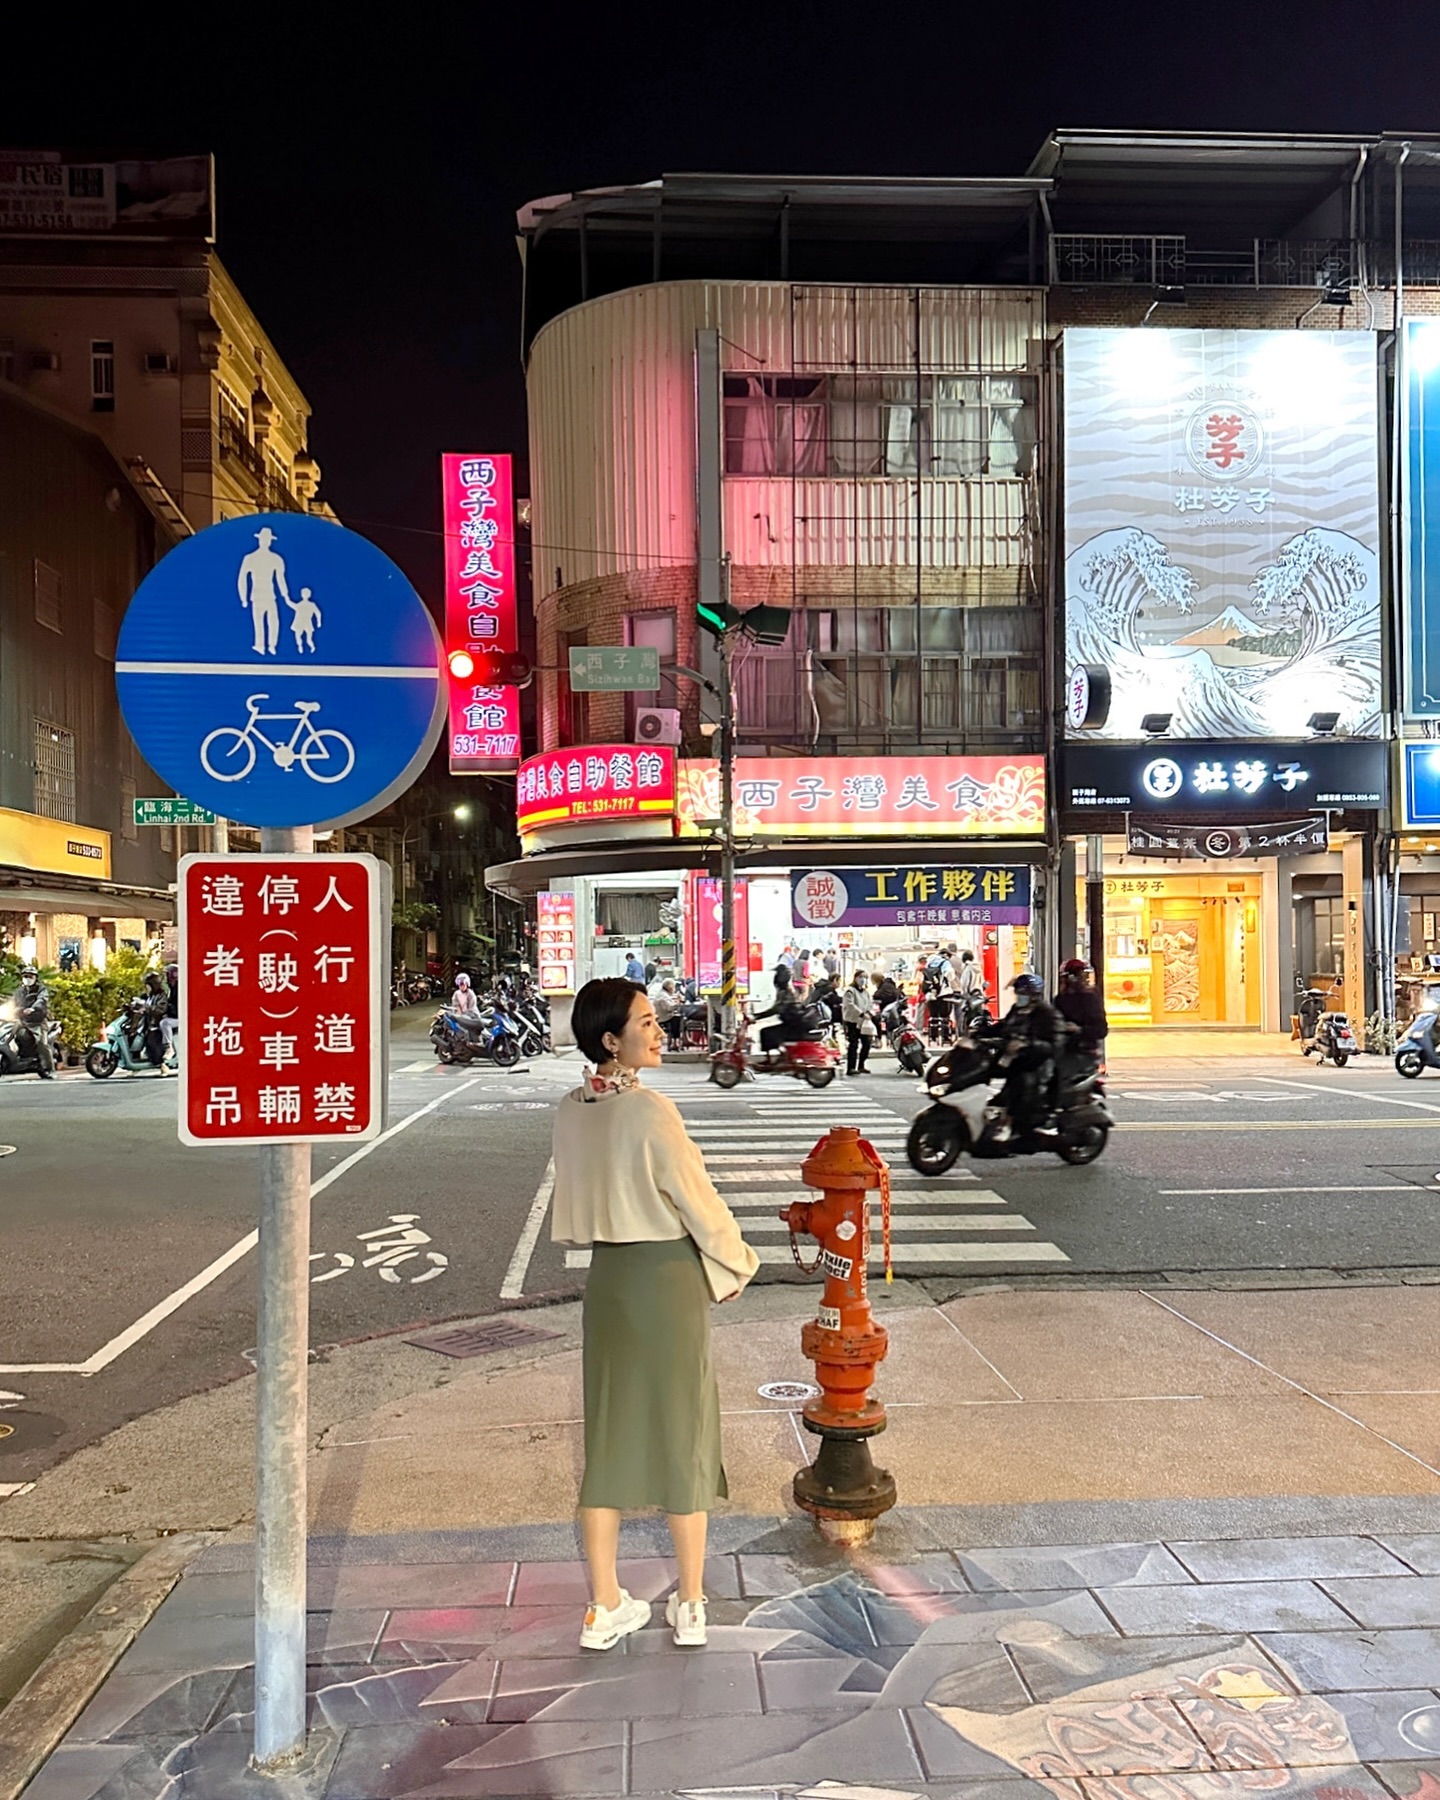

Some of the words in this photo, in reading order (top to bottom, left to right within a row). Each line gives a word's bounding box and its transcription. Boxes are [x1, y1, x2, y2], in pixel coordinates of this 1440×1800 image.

[1174, 486, 1276, 514] 杜芳子
[460, 459, 505, 729] 西子灣美食自館
[587, 652, 657, 669] 西子灣
[587, 673, 633, 685] Sizihwan
[637, 673, 657, 686] Bay
[454, 736, 516, 754] 531-7117
[737, 774, 990, 811] 西子灣美食
[1192, 761, 1309, 793] 杜芳子
[144, 813, 172, 823] Linhai
[173, 813, 190, 823] 2nd
[191, 813, 207, 823] Rd.
[806, 876, 836, 919] 誠徵
[864, 869, 1015, 902] 工作夥伴
[201, 875, 245, 1126] 違者拖吊
[312, 876, 356, 1123] 人行道禁
